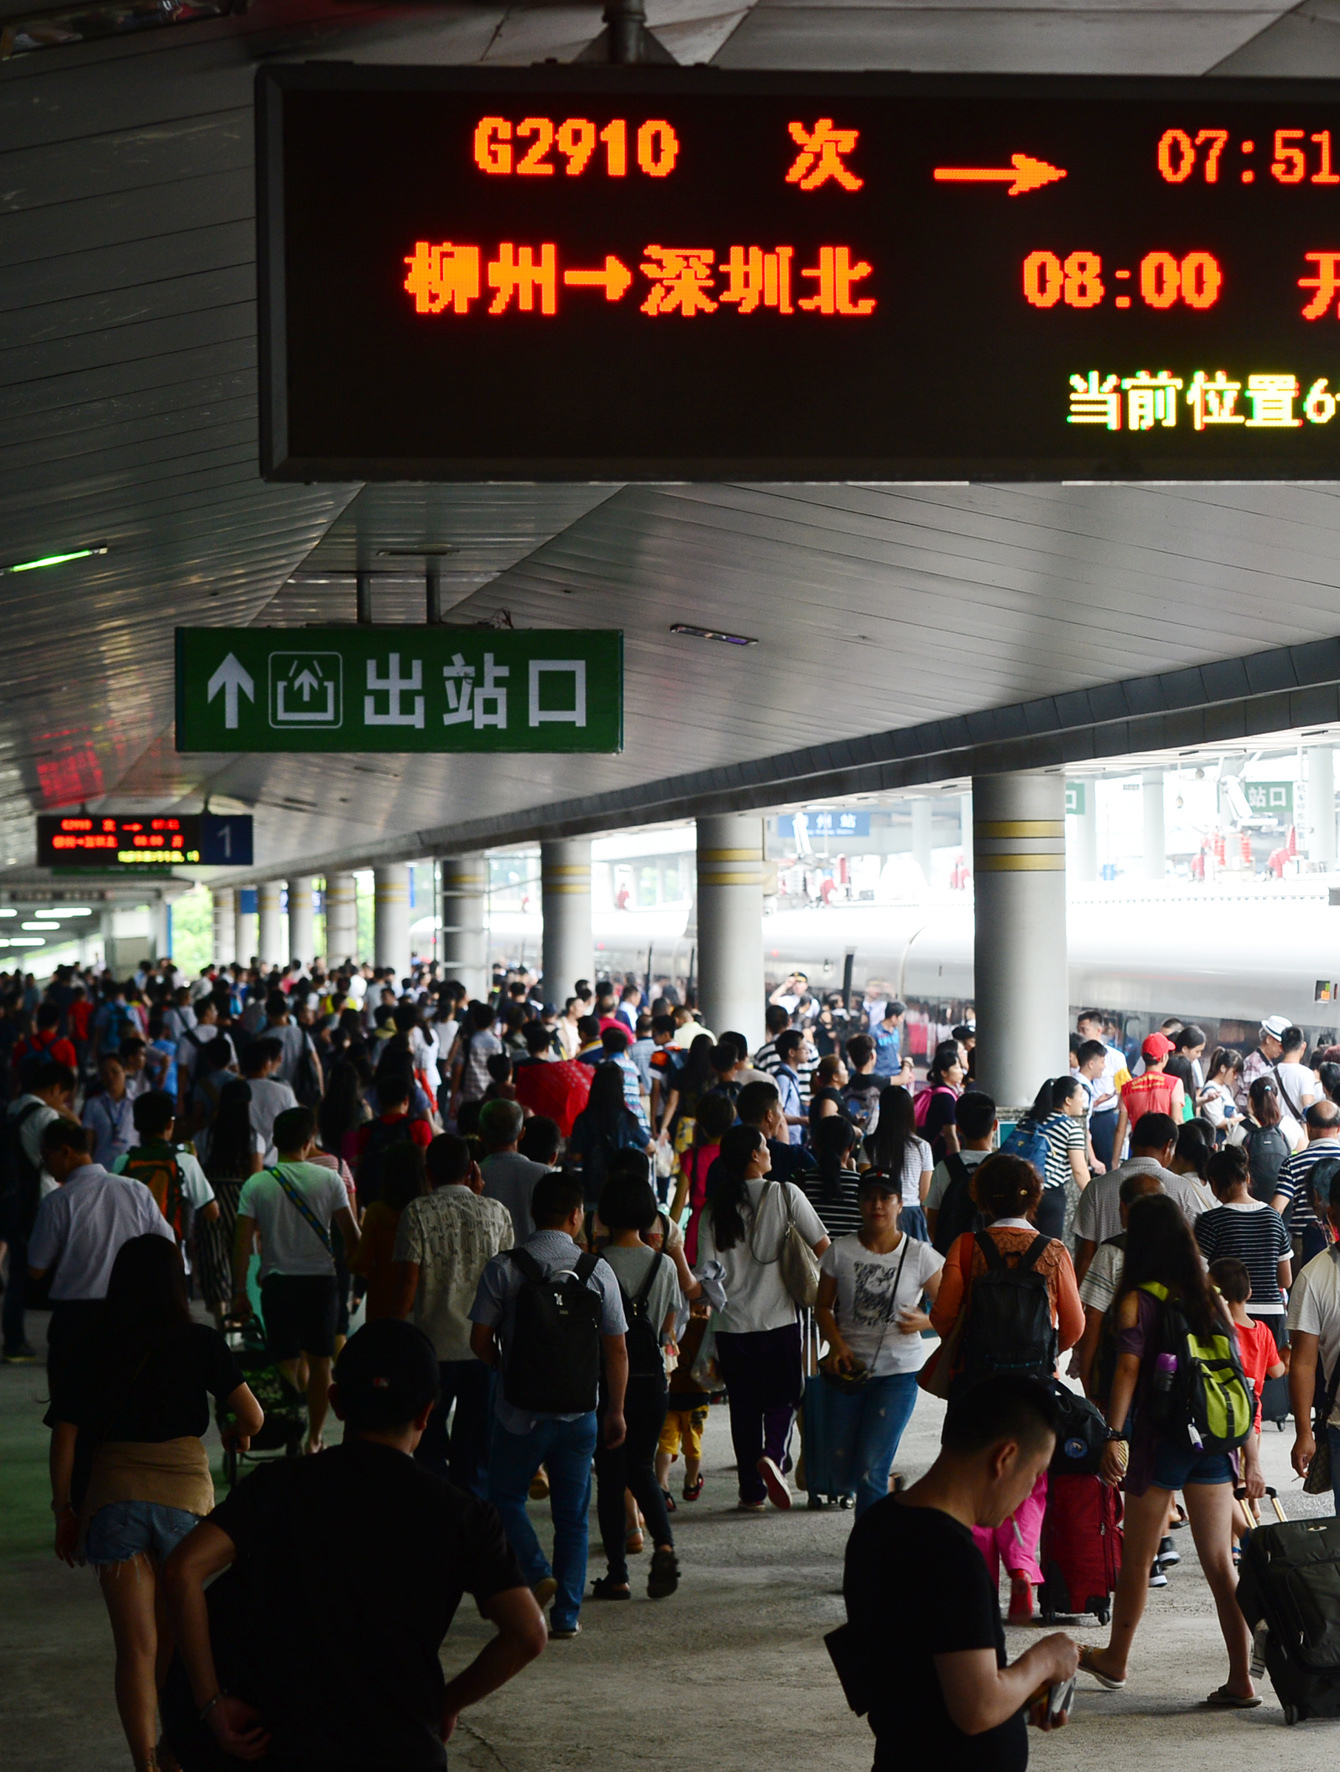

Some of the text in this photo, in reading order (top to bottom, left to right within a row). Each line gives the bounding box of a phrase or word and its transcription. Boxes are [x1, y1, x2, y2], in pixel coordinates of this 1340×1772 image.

[473, 117, 679, 177] G2910
[784, 118, 864, 190] 次
[1157, 129, 1340, 184] 07:51
[1022, 250, 1222, 309] 08:00
[363, 652, 588, 729] 出站口
[217, 824, 231, 858] 1
